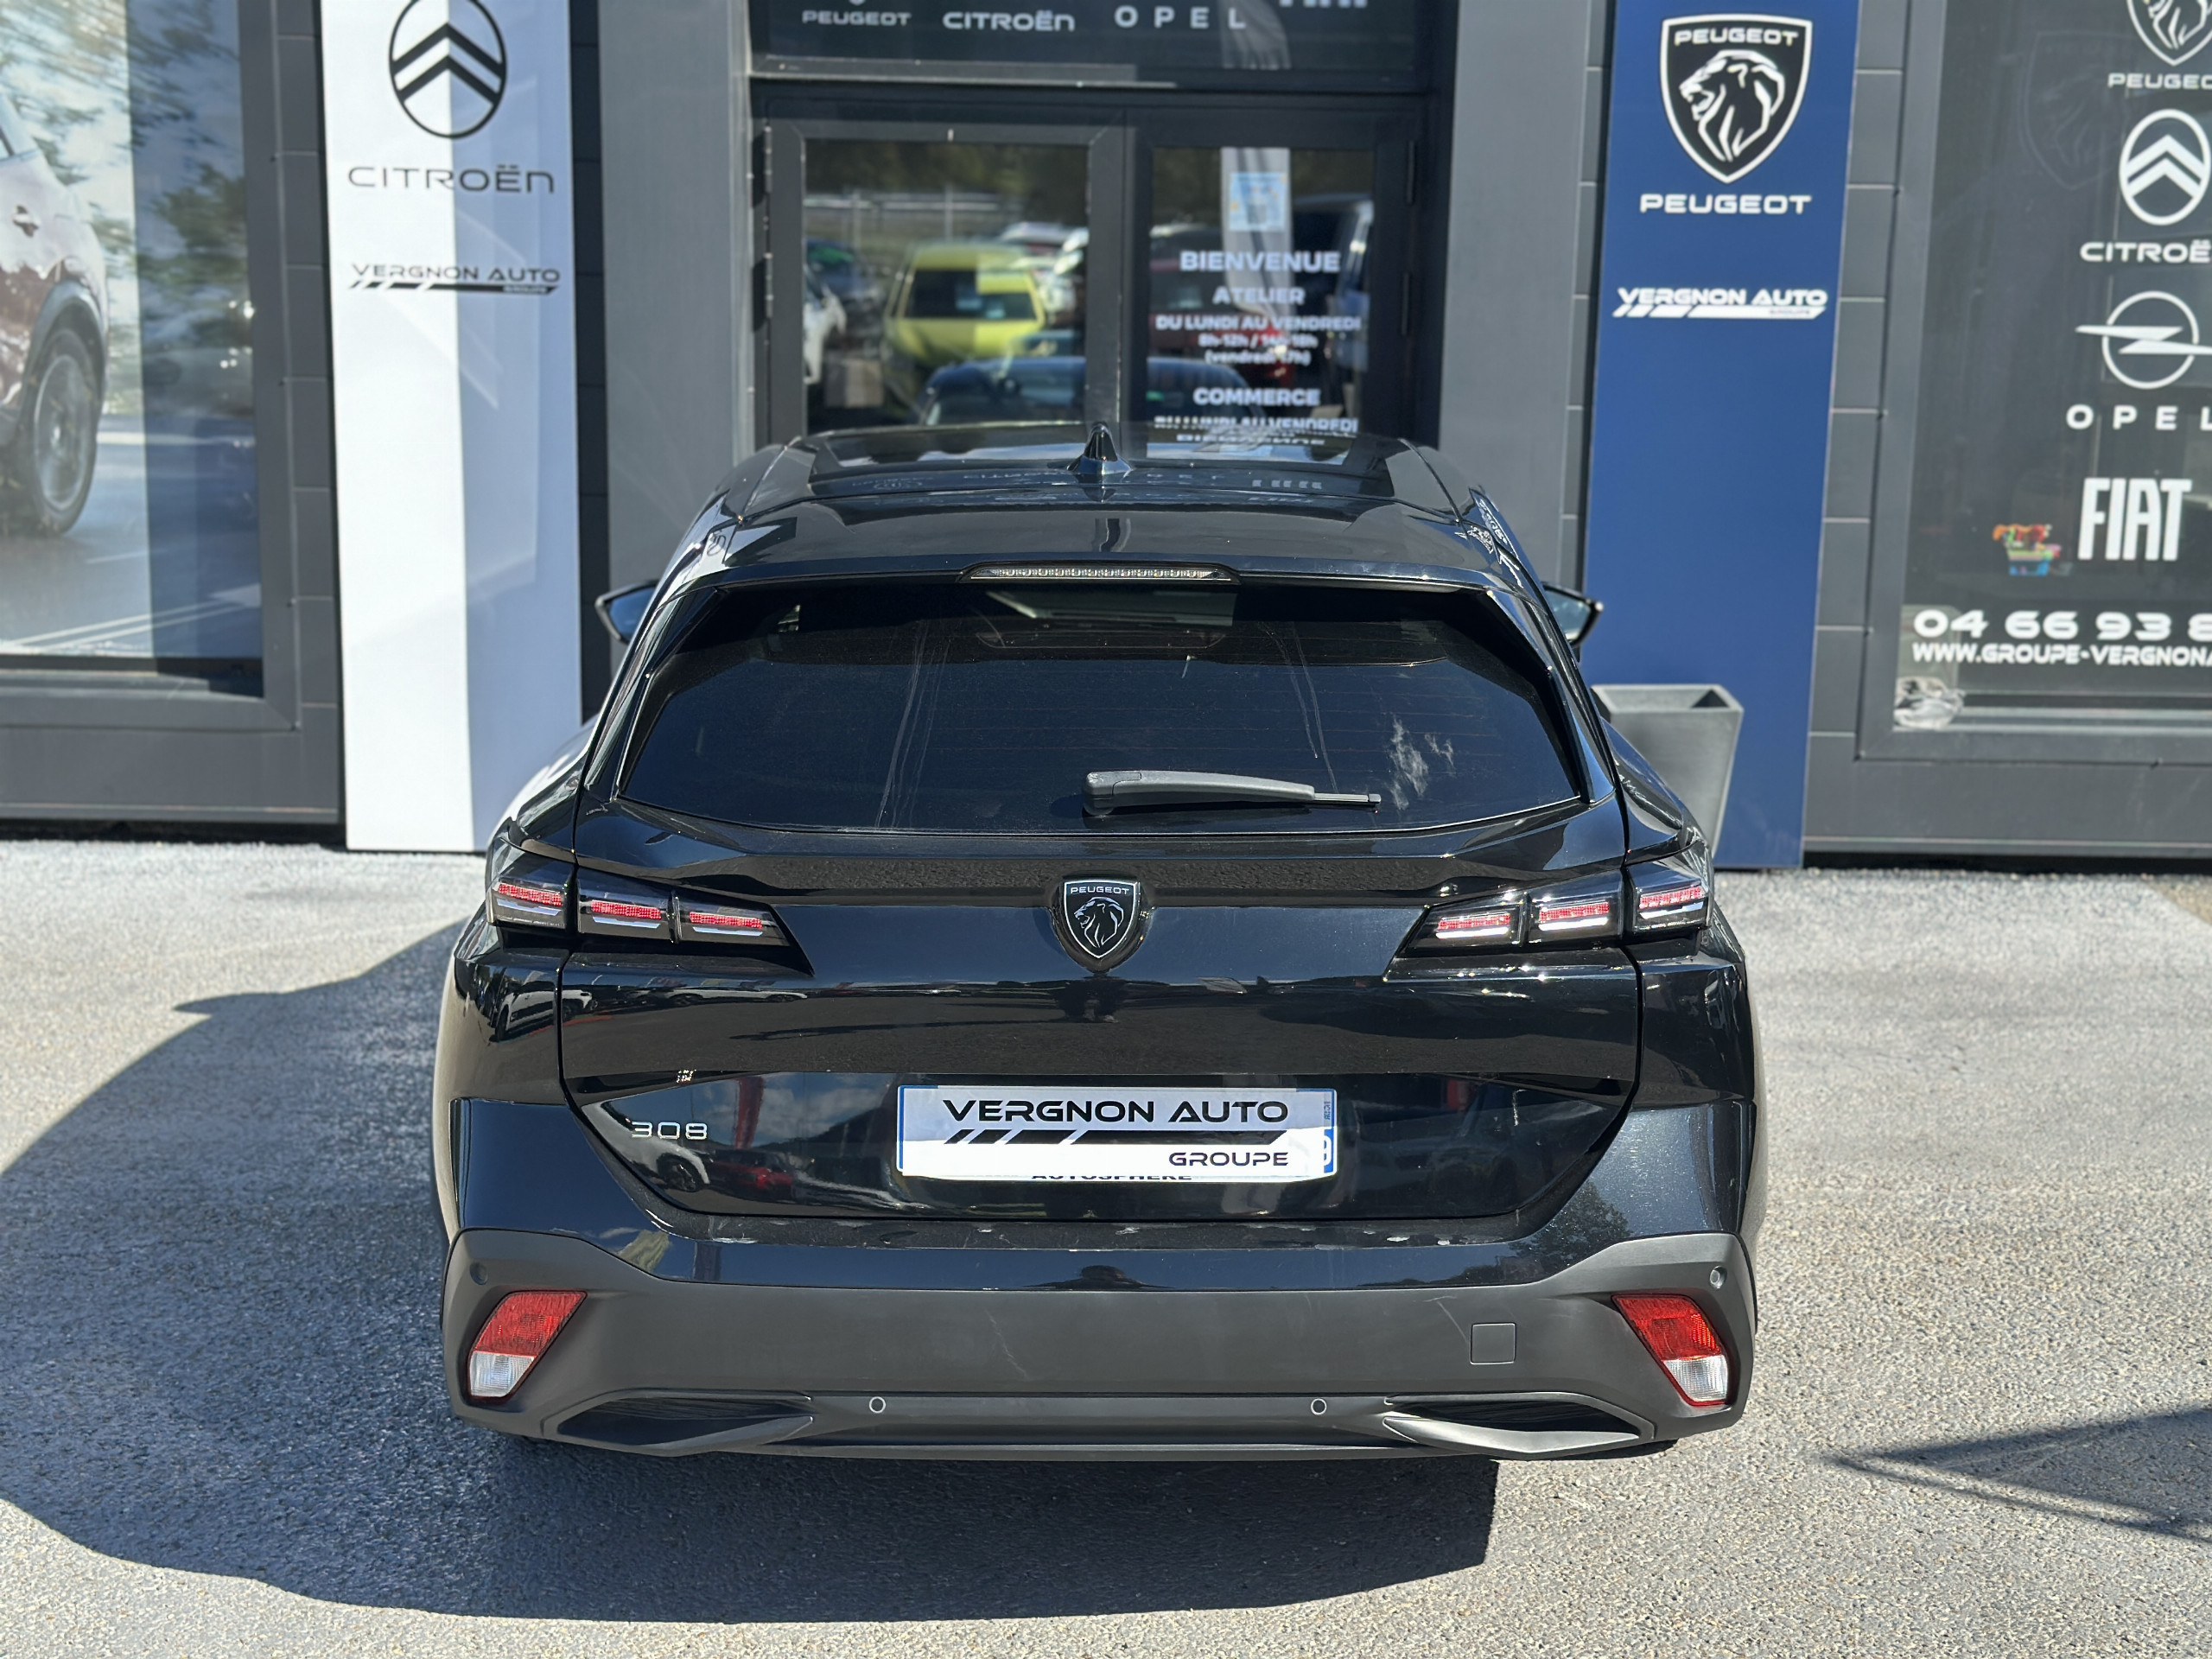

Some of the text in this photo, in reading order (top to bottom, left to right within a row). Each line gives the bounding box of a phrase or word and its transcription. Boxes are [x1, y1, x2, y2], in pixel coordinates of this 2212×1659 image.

[803, 10, 911, 26] PEUGEOT
[1115, 6, 1246, 29] OPEL
[1675, 28, 1798, 46] PEUGEOT
[1640, 194, 1811, 213] PEUGEOT
[1180, 251, 1340, 272] BIENVENUE
[353, 264, 560, 283] VERGNON AUTO
[1212, 287, 1306, 304] ATELIER
[1618, 288, 1828, 306] VERGNON AUTO
[1155, 315, 1362, 331] DU LUNDI AU VENDREDI
[1193, 388, 1321, 406] COMMERCE
[2077, 478, 2192, 561] FIAT
[1913, 609, 1988, 638] 04
[2005, 611, 2078, 639] 66
[2095, 612, 2171, 641] 93
[943, 1099, 1288, 1123] VERGNON AUTO
[632, 1122, 708, 1140] 308
[1169, 1152, 1288, 1166] GROUPE
